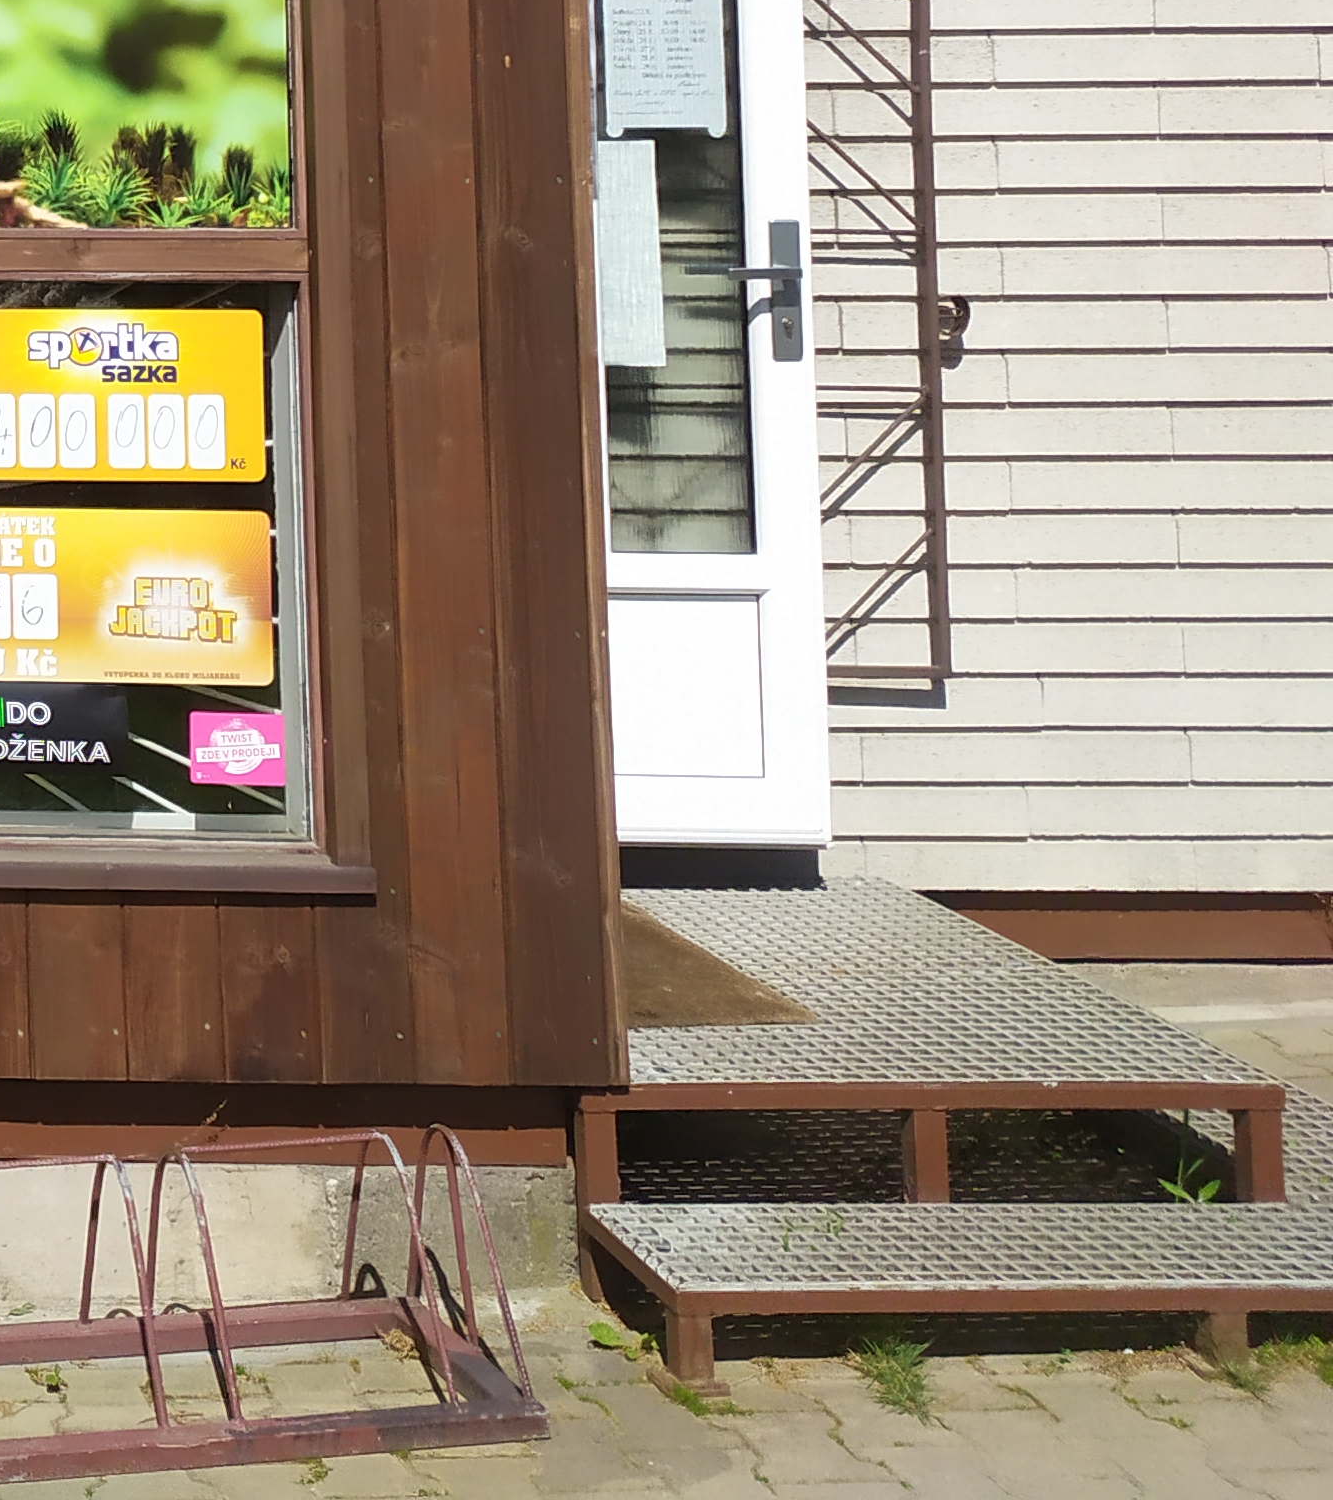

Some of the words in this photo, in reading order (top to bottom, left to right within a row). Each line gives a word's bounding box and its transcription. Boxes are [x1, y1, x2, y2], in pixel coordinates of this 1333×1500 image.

[28, 323, 179, 370] sportka
[231, 459, 246, 469] Kč
[33, 538, 56, 567] O
[134, 576, 211, 608] EURO
[108, 605, 238, 643] JACKPOT
[16, 649, 58, 677] Kč
[221, 733, 253, 743] TWIST
[201, 750, 221, 760] ZDE
[221, 749, 228, 758] V
[232, 747, 276, 758] PRODEJI
